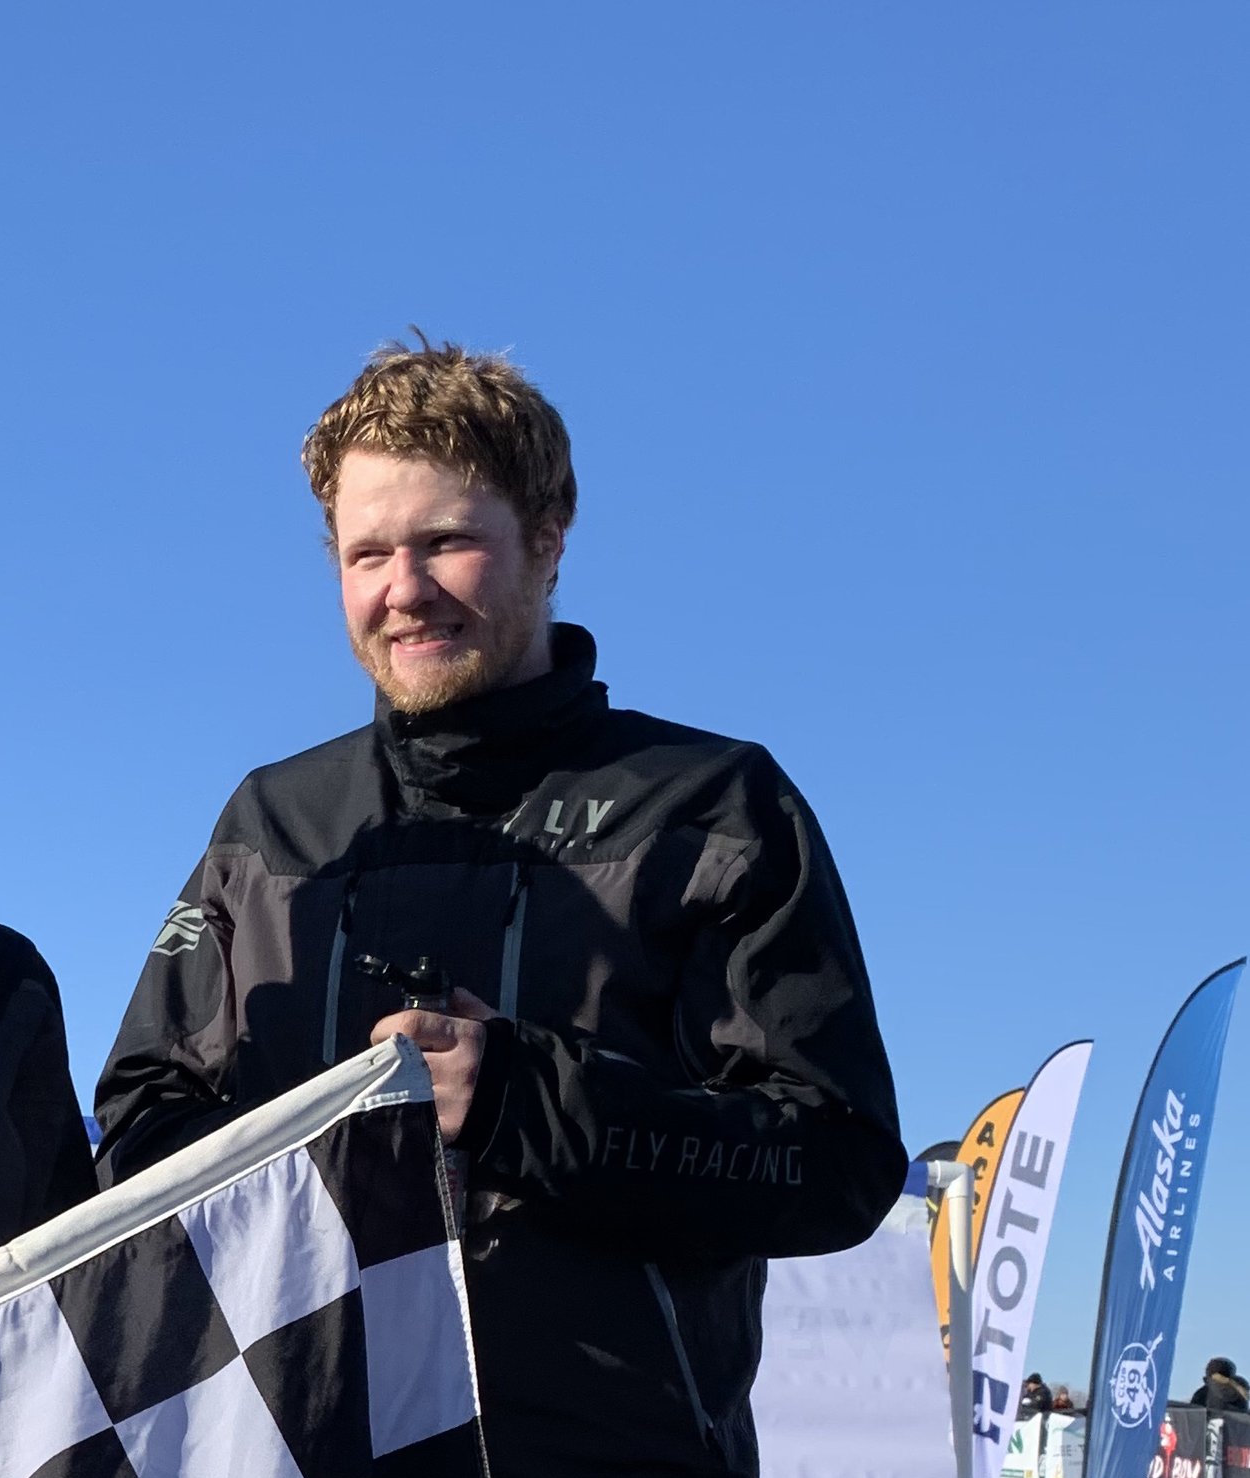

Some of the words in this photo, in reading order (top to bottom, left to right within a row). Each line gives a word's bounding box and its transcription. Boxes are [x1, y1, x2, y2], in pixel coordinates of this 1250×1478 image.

[502, 799, 616, 835] LY
[602, 1126, 668, 1172] FLY
[677, 1136, 803, 1185] RACING
[1135, 1088, 1184, 1291] Alaska
[1163, 1112, 1201, 1282] AIRLINES
[973, 1130, 1056, 1357] TOTE
[1126, 1367, 1142, 1398] 49
